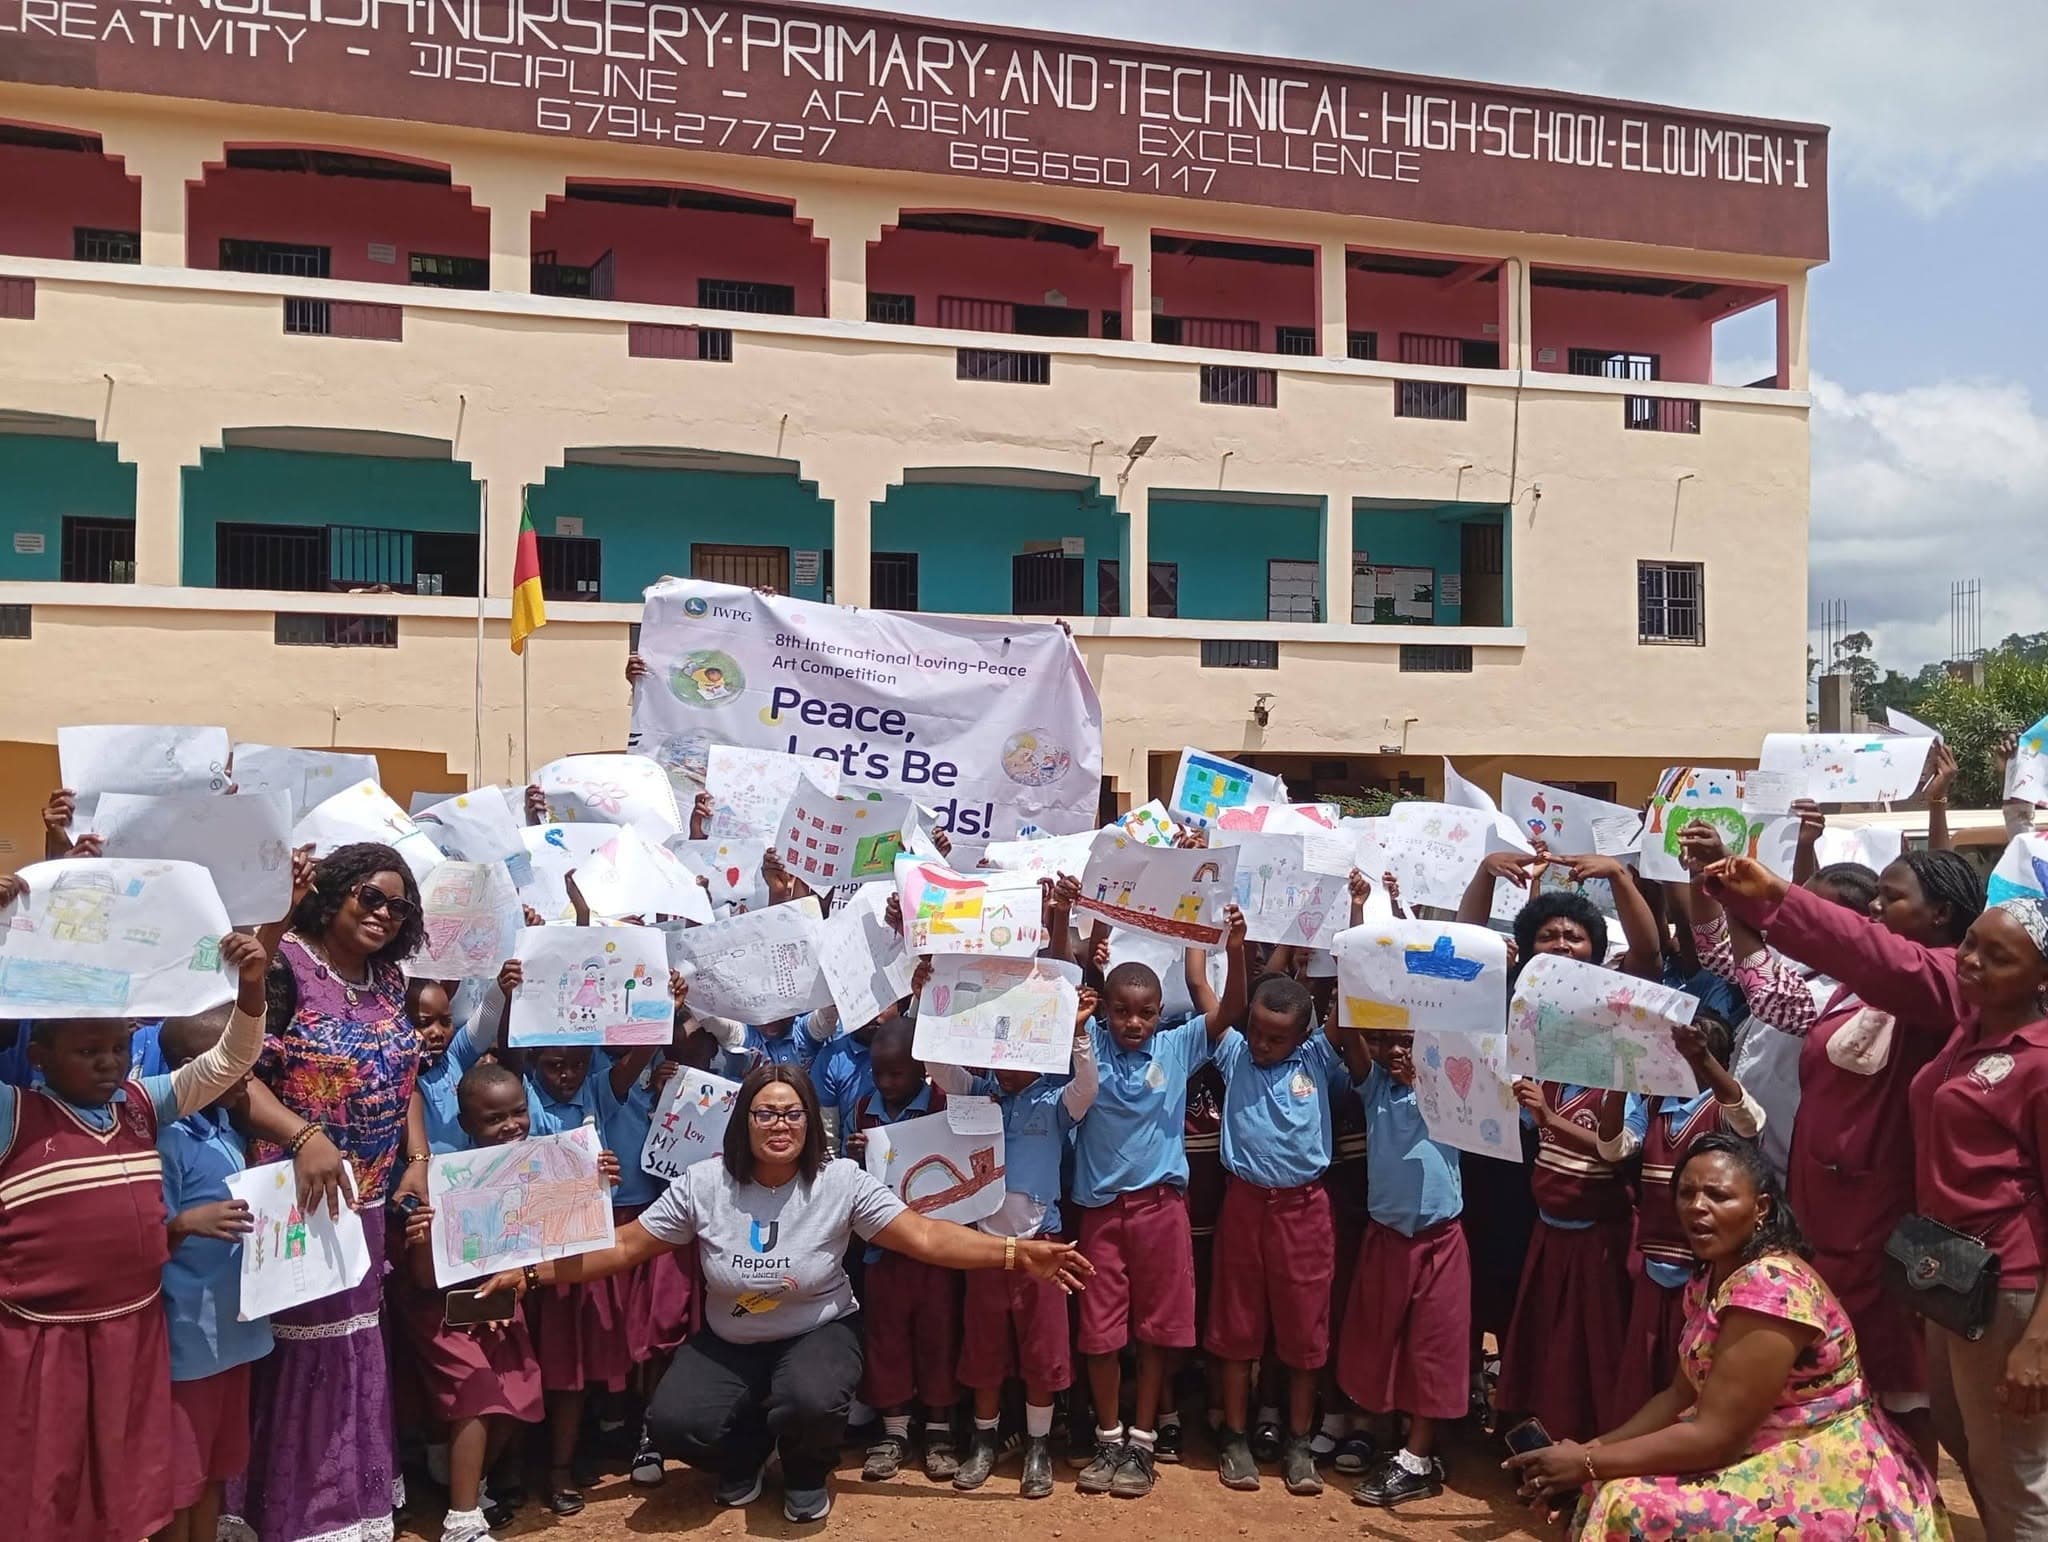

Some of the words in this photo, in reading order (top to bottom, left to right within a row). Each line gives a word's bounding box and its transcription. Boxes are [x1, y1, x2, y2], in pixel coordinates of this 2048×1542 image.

[409, 41, 678, 104] DISCIPLINE
[802, 88, 1031, 143] ACADEMIC
[1138, 123, 1421, 184] EXCELLENCE
[537, 97, 838, 157] 679427727
[713, 606, 752, 622] IWPG
[775, 633, 801, 649] 8th
[805, 637, 912, 667] International
[772, 655, 797, 671] Art
[800, 659, 897, 686] Competition
[770, 692, 915, 743] Peace,
[901, 750, 959, 787] Be
[651, 1132, 679, 1153] MY
[731, 1254, 791, 1272] Report
